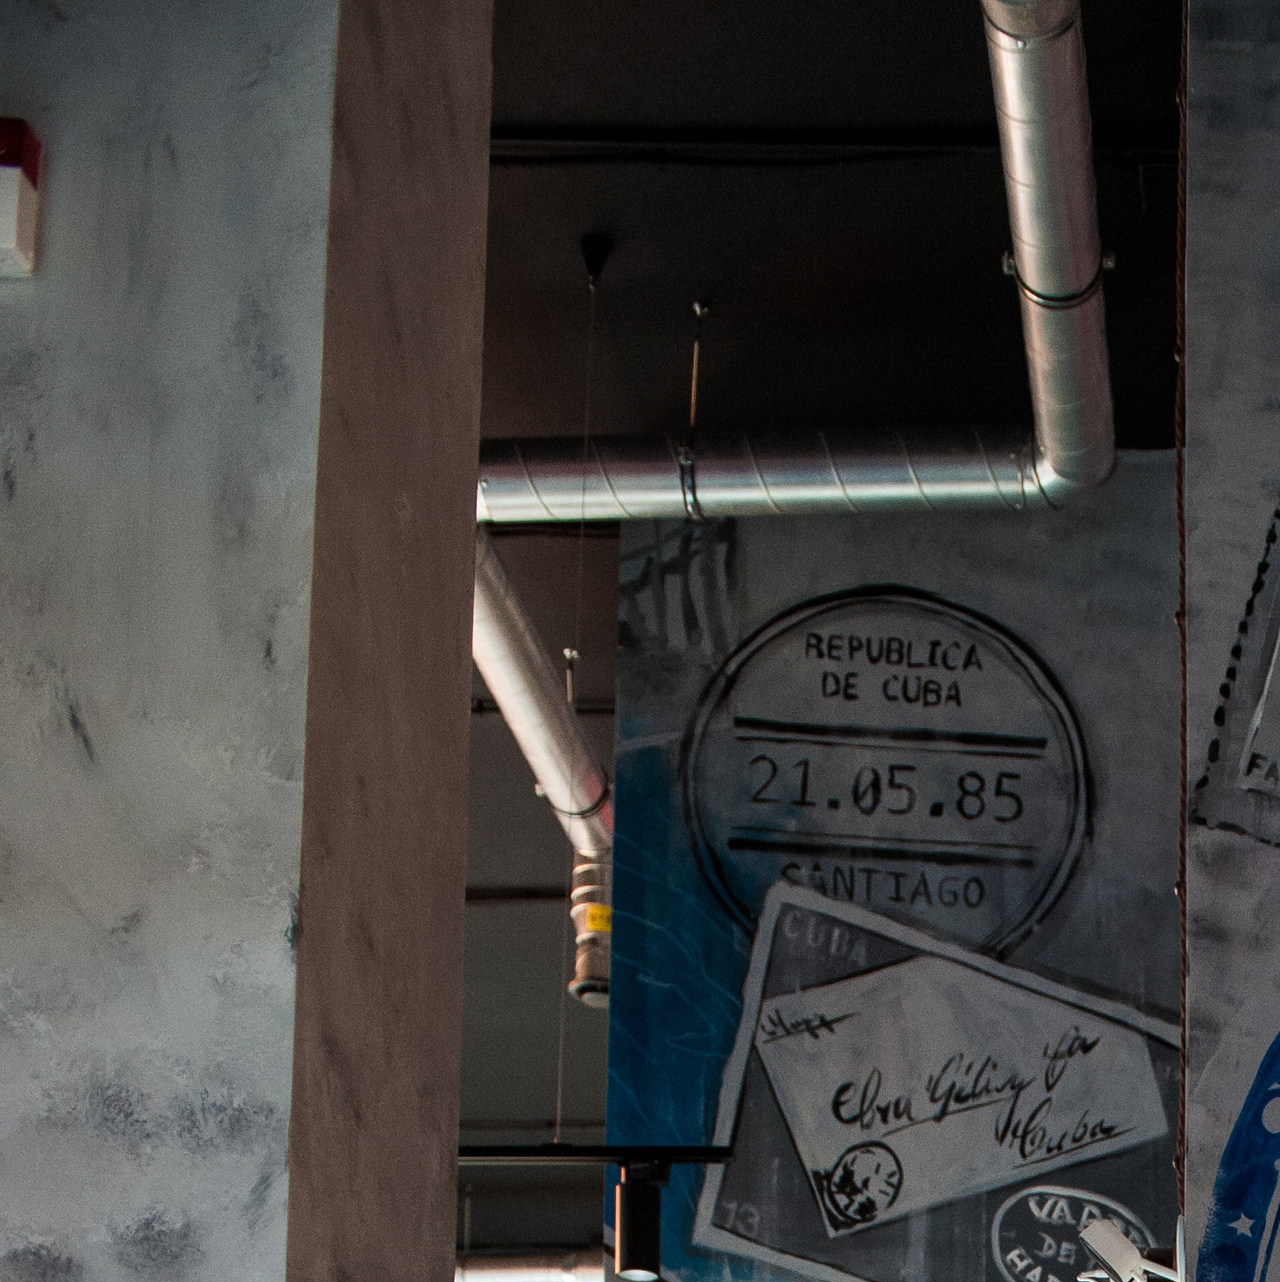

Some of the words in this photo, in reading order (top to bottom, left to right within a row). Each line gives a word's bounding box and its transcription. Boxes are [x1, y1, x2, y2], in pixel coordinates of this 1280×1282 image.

[804, 630, 984, 673] REPUBLICA
[822, 672, 860, 701] DE
[883, 676, 964, 708] CUBA
[747, 754, 1025, 822] 21.05.85
